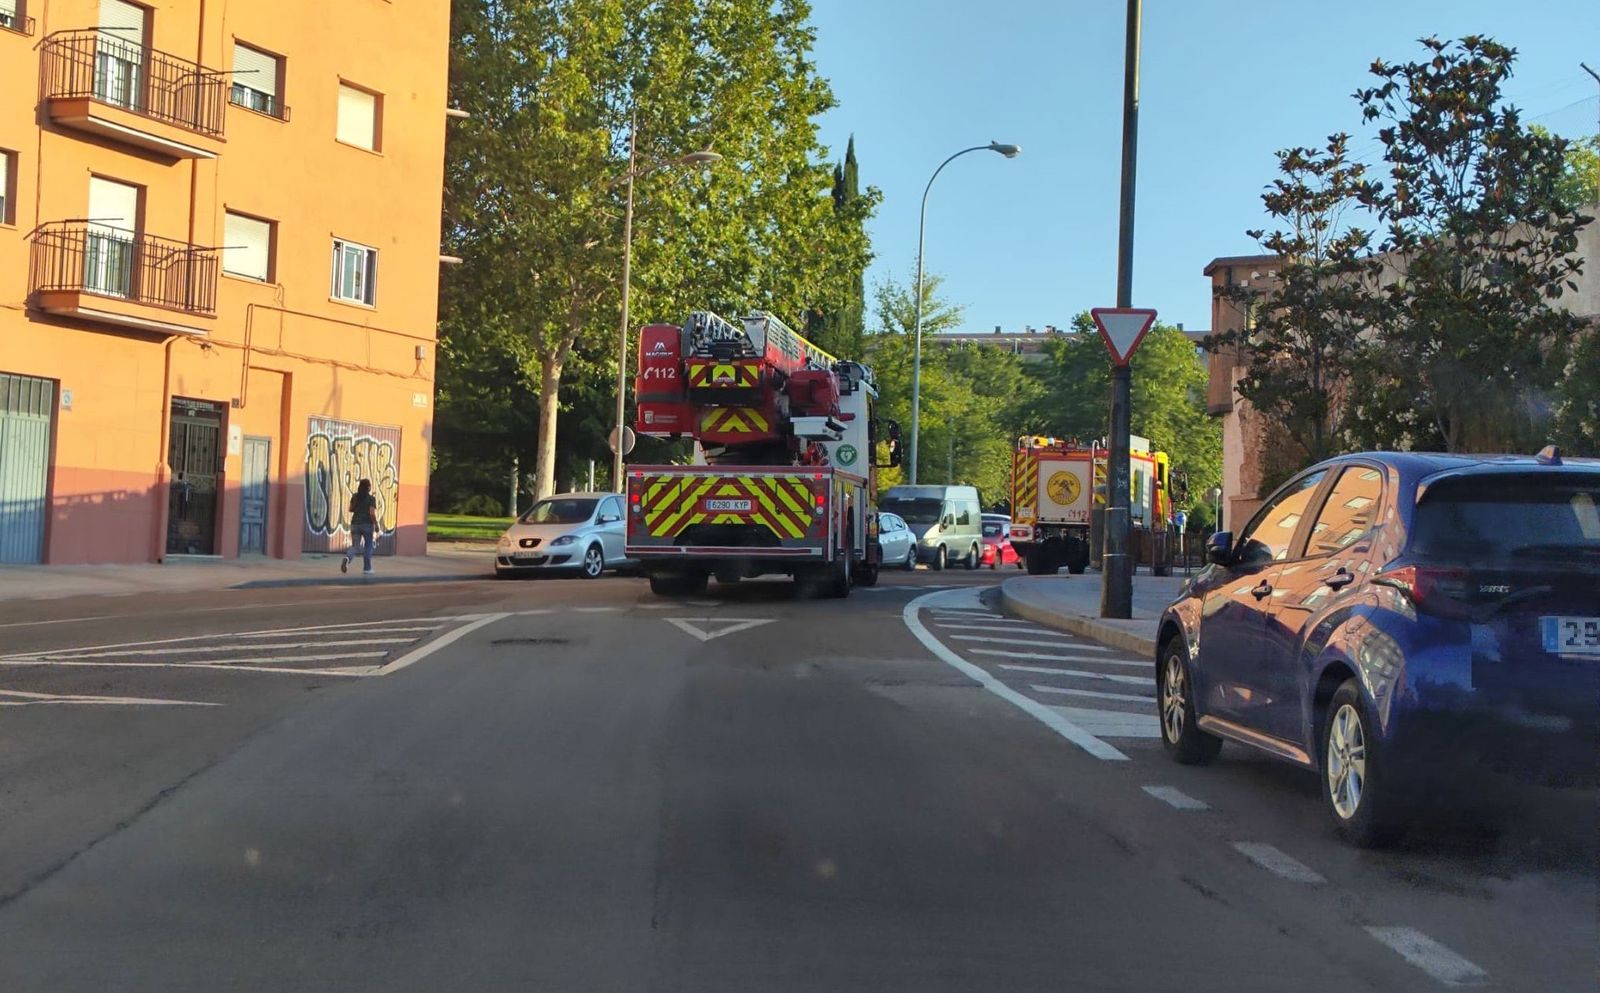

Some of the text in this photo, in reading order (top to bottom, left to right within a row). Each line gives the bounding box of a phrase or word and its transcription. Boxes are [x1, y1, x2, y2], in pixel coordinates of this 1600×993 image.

[653, 367, 676, 379] 112
[712, 501, 749, 509] 6290 KYP
[1072, 509, 1088, 518] 112
